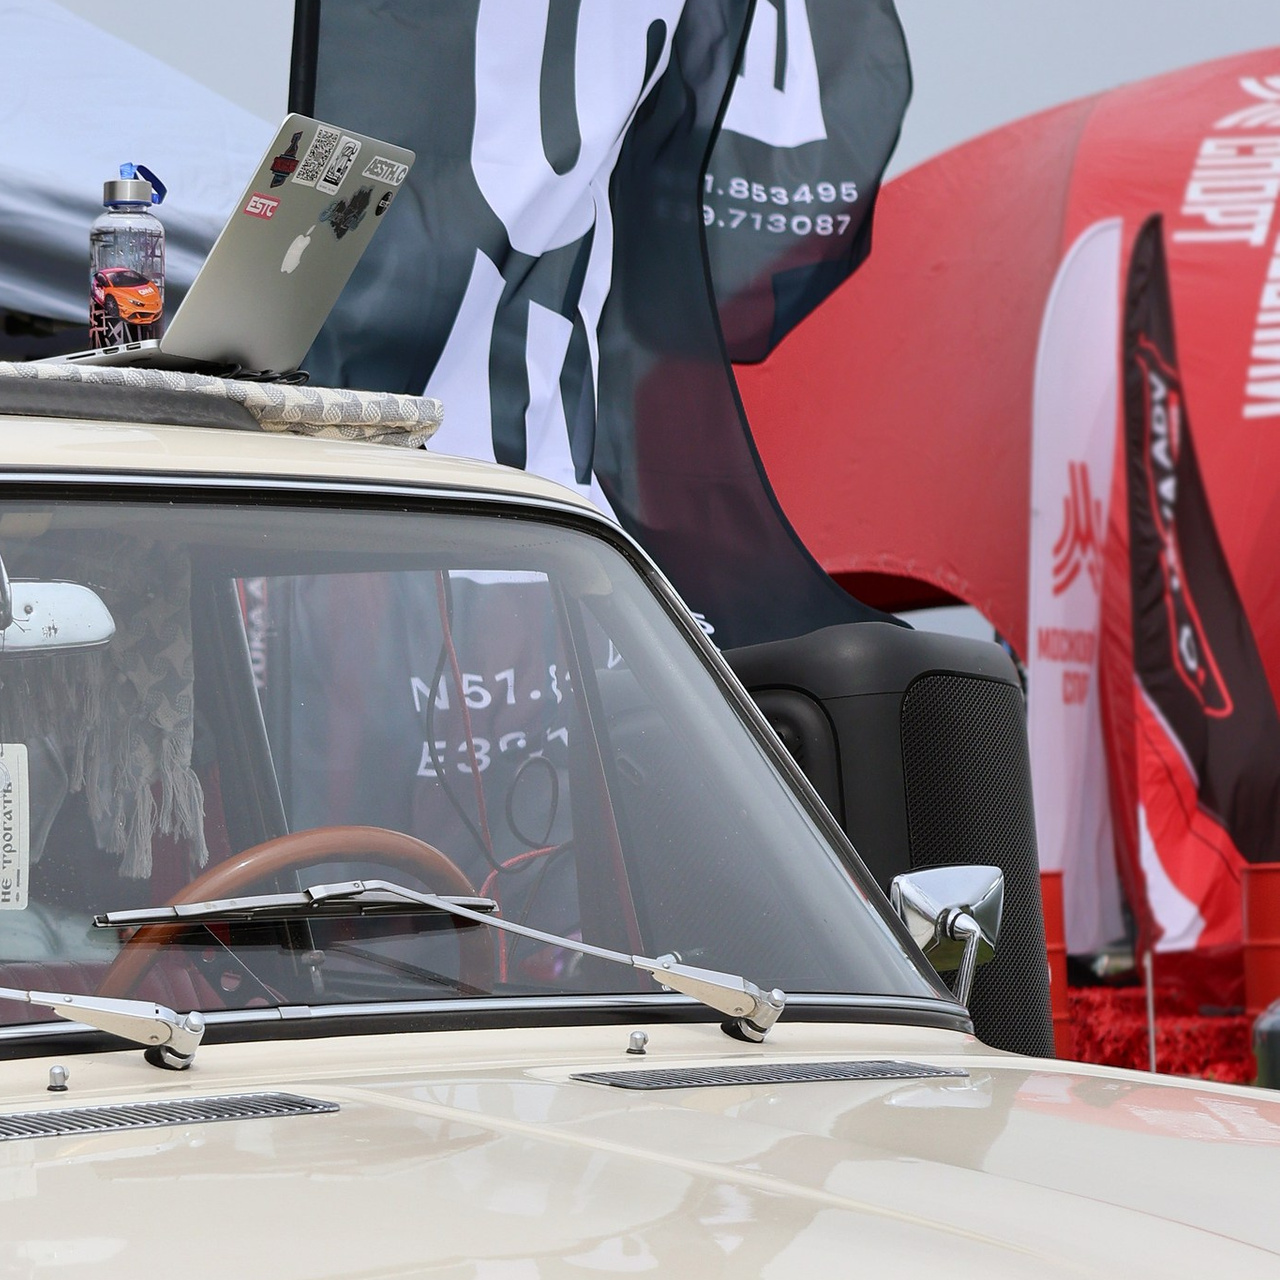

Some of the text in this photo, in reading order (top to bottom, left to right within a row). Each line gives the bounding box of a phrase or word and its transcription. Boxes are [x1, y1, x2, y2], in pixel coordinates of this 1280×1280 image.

[704, 173, 859, 206] 1.853495
[245, 195, 279, 217] ESTC
[703, 204, 851, 236] 9.713087
[2, 781, 17, 870] трогать
